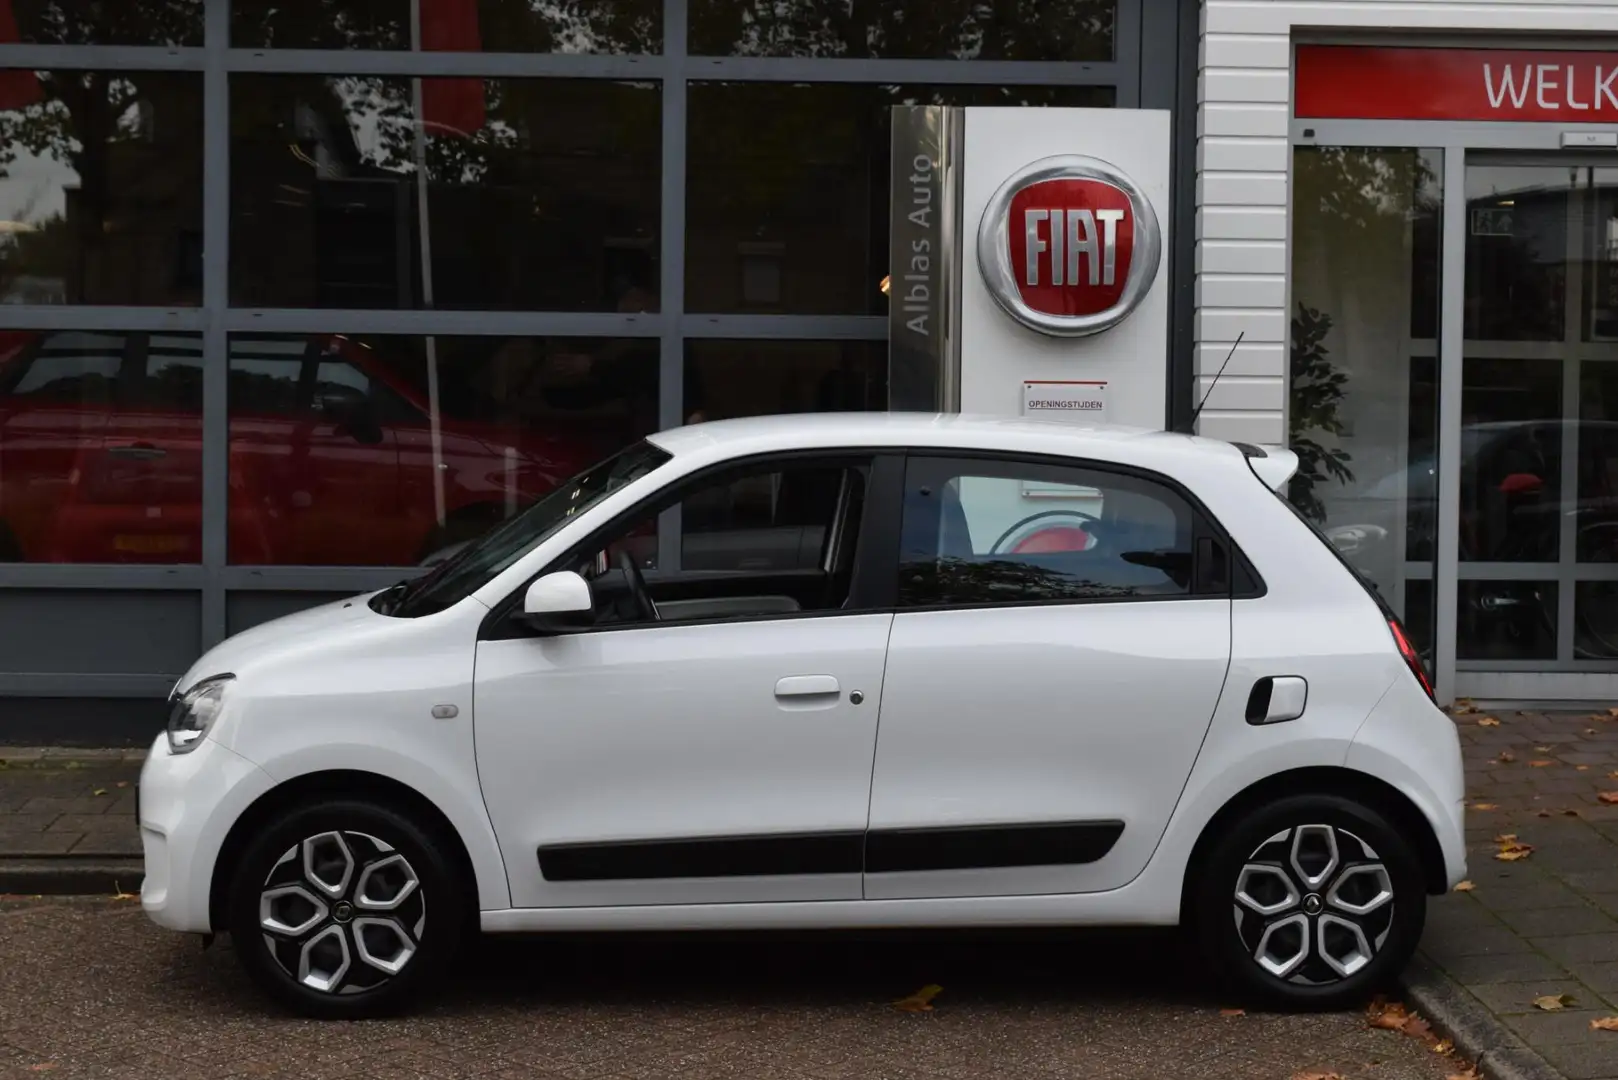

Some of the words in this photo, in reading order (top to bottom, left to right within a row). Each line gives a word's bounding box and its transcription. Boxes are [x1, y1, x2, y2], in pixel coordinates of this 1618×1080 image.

[1483, 63, 1618, 110] WELK
[907, 154, 932, 228] Auto
[1024, 209, 1124, 286] FIAT
[904, 239, 930, 336] Alblas
[1028, 400, 1103, 409] OPENINGSTIJDEN
